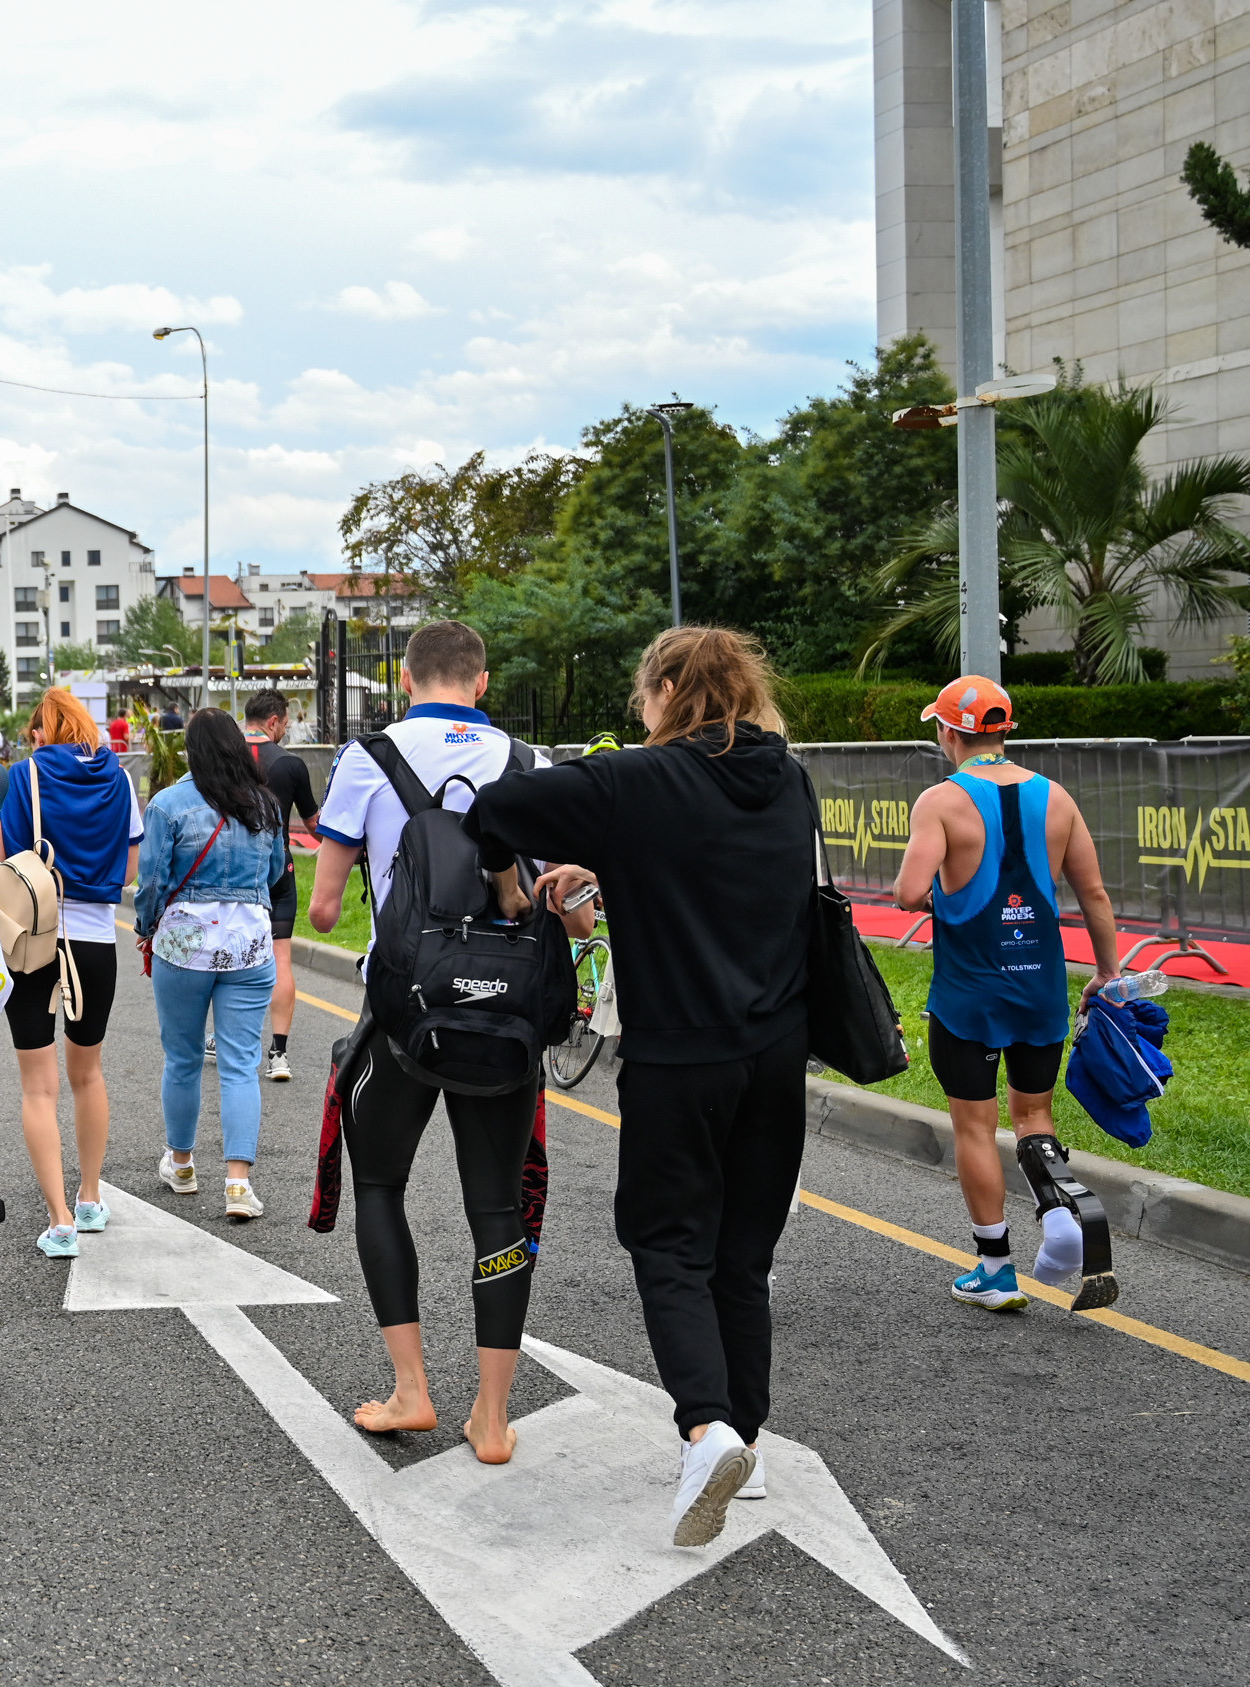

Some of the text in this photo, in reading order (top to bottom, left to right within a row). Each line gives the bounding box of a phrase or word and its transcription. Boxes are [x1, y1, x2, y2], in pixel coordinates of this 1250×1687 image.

[820, 798, 909, 836] IRON STAR
[1137, 805, 1187, 850] IRON
[452, 978, 508, 993] speedo
[478, 1248, 525, 1277] MAKO
